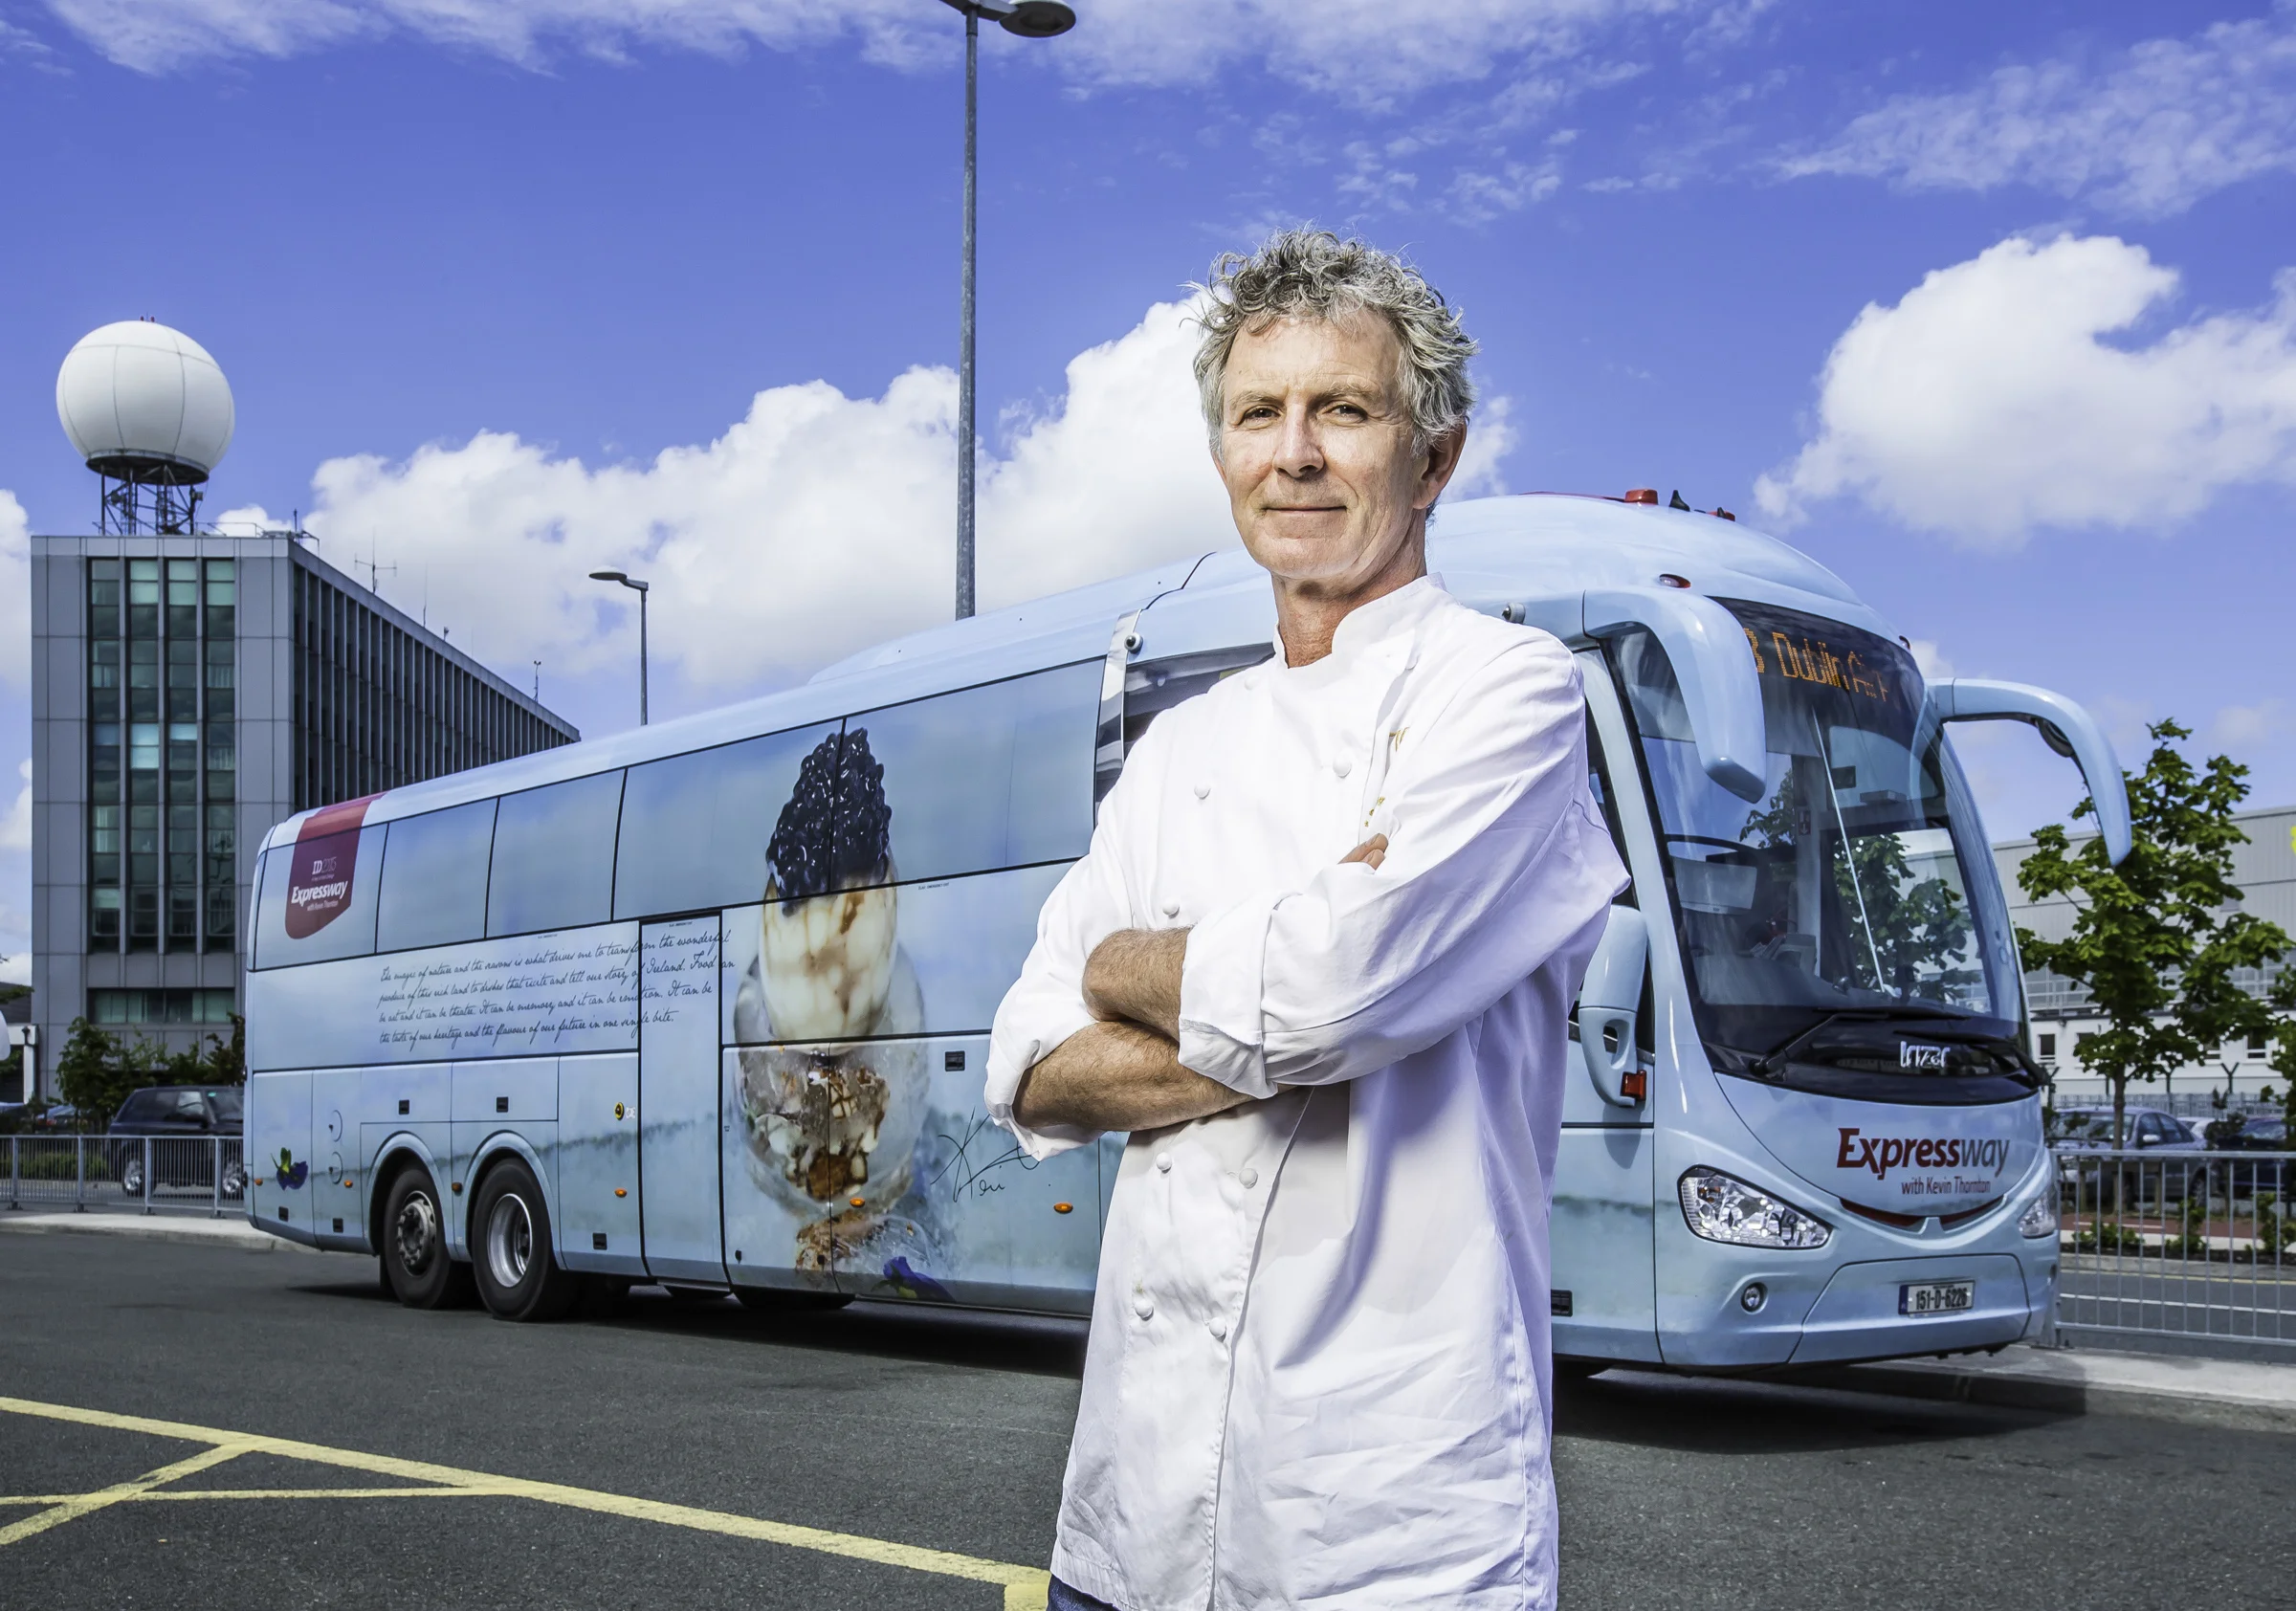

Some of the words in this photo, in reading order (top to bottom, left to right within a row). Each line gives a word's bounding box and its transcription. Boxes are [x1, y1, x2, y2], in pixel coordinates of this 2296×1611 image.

[1772, 631, 1850, 691] Dublin
[291, 880, 348, 907] Expressway
[376, 990, 405, 1010] produce
[408, 988, 419, 1010] of
[417, 985, 432, 999] this
[433, 984, 449, 997] rich
[451, 982, 470, 995] land
[471, 980, 482, 993] to
[480, 979, 504, 993] dishes
[506, 974, 532, 990] that
[549, 972, 568, 985] and
[569, 969, 585, 983] tell
[586, 973, 602, 982] our
[605, 964, 629, 986] story
[647, 958, 686, 974] Ireland.
[690, 950, 717, 969] Food
[720, 960, 736, 969] an
[381, 965, 391, 982] The
[394, 967, 415, 991] magic
[414, 965, 429, 992] of
[429, 962, 453, 976] nature
[454, 961, 471, 973] and
[471, 958, 484, 972] the
[515, 953, 523, 966] is
[525, 949, 553, 965] what
[549, 948, 576, 962] drives
[595, 942, 606, 958] to
[659, 933, 675, 948] the
[676, 929, 732, 956] wonderfl
[379, 1012, 386, 1023] be
[387, 1009, 405, 1022] art
[400, 1009, 415, 1021] and
[416, 1006, 430, 1020] it
[439, 1006, 447, 1017] be
[479, 999, 497, 1014] It
[506, 1001, 515, 1012] be
[518, 1001, 555, 1016] memory
[558, 995, 576, 1007] and
[578, 991, 595, 1006] it
[607, 991, 616, 1004] be
[668, 980, 689, 997] It
[681, 987, 699, 996] can
[702, 981, 712, 994] be
[380, 1030, 391, 1044] the
[392, 1029, 411, 1043] taste
[409, 1029, 419, 1052] of
[433, 1026, 462, 1050] heritage
[464, 1026, 480, 1037] and
[482, 1024, 494, 1037] the
[529, 1021, 541, 1045] of
[541, 1024, 555, 1032] our
[554, 1016, 586, 1044] future
[589, 1014, 601, 1028] in
[1837, 1128, 2010, 1181] Expressway
[1901, 1177, 1925, 1195] with
[1926, 1177, 1953, 1194] Kevin
[1954, 1175, 1991, 1194] Thornton
